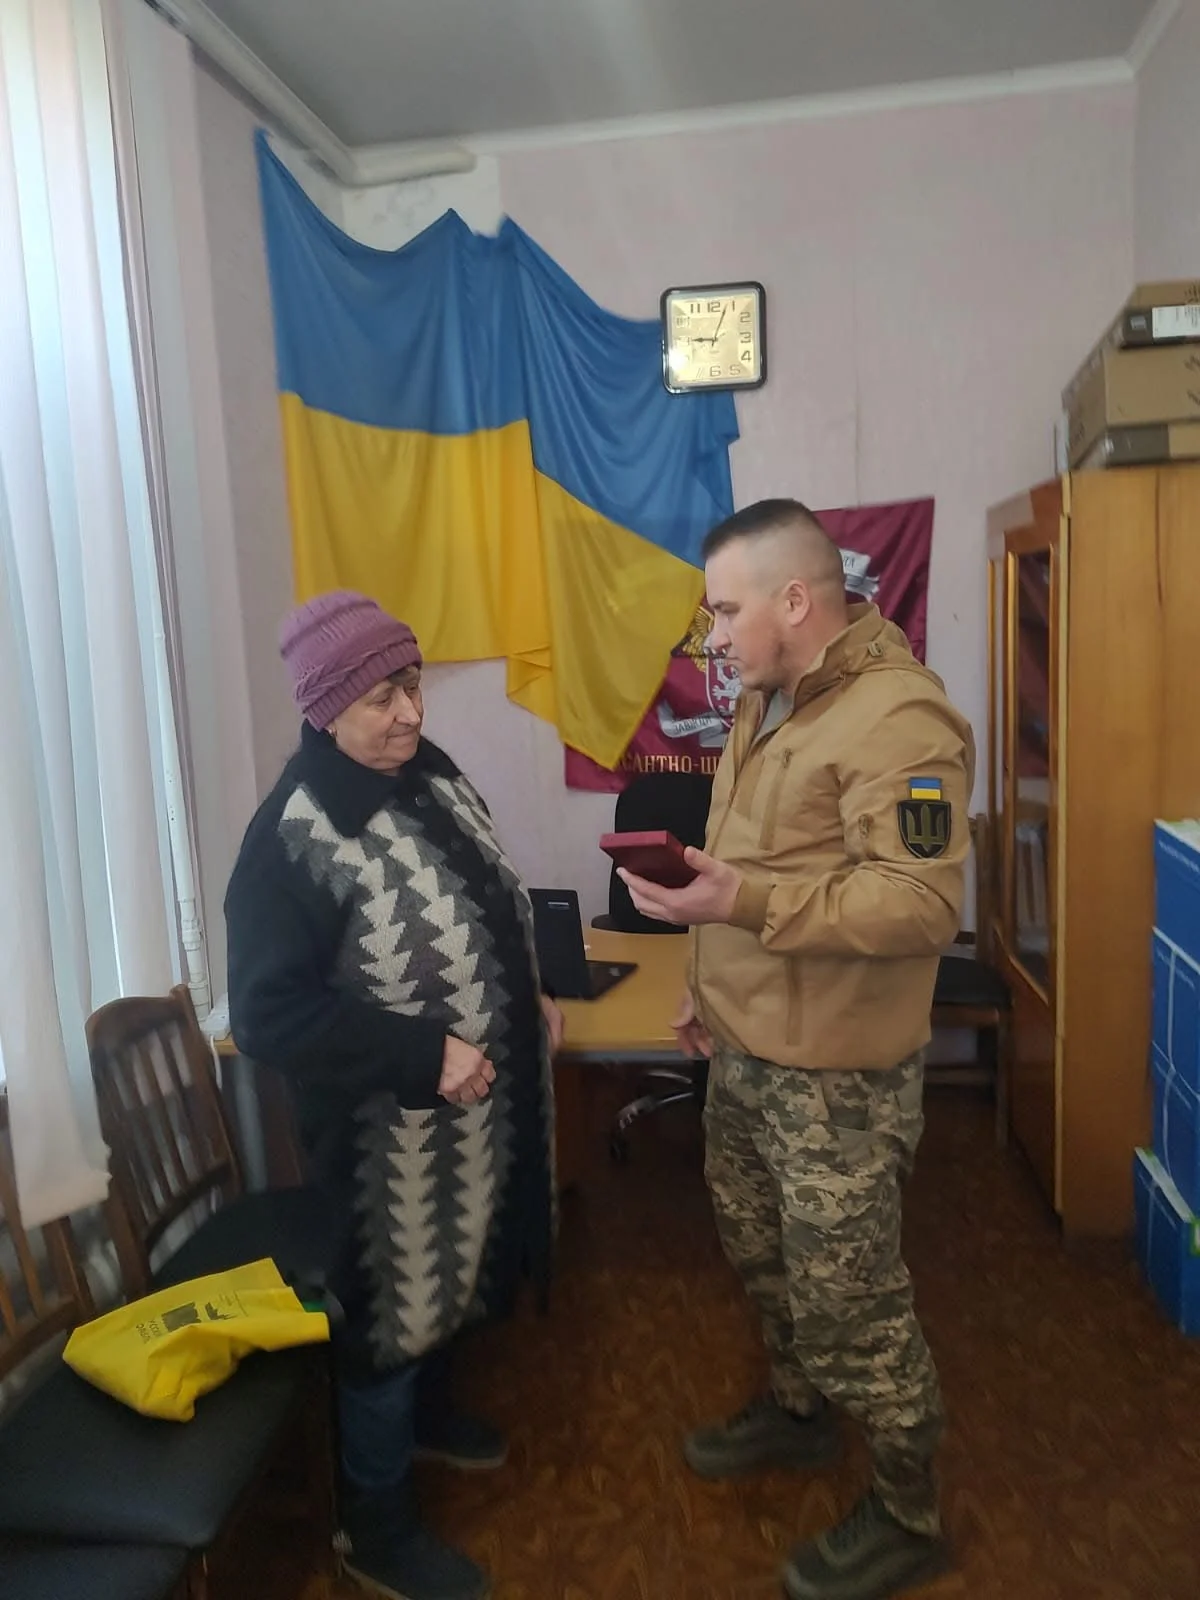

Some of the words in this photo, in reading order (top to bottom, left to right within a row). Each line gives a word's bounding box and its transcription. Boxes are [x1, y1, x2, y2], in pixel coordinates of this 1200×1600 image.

[690, 303, 701, 314] 11
[707, 301, 721, 313] 12
[732, 299, 735, 312] 1
[740, 311, 751, 323] 2
[740, 331, 751, 344] 3
[741, 350, 751, 362] 4
[709, 365, 721, 377] 6
[729, 364, 741, 376] 5
